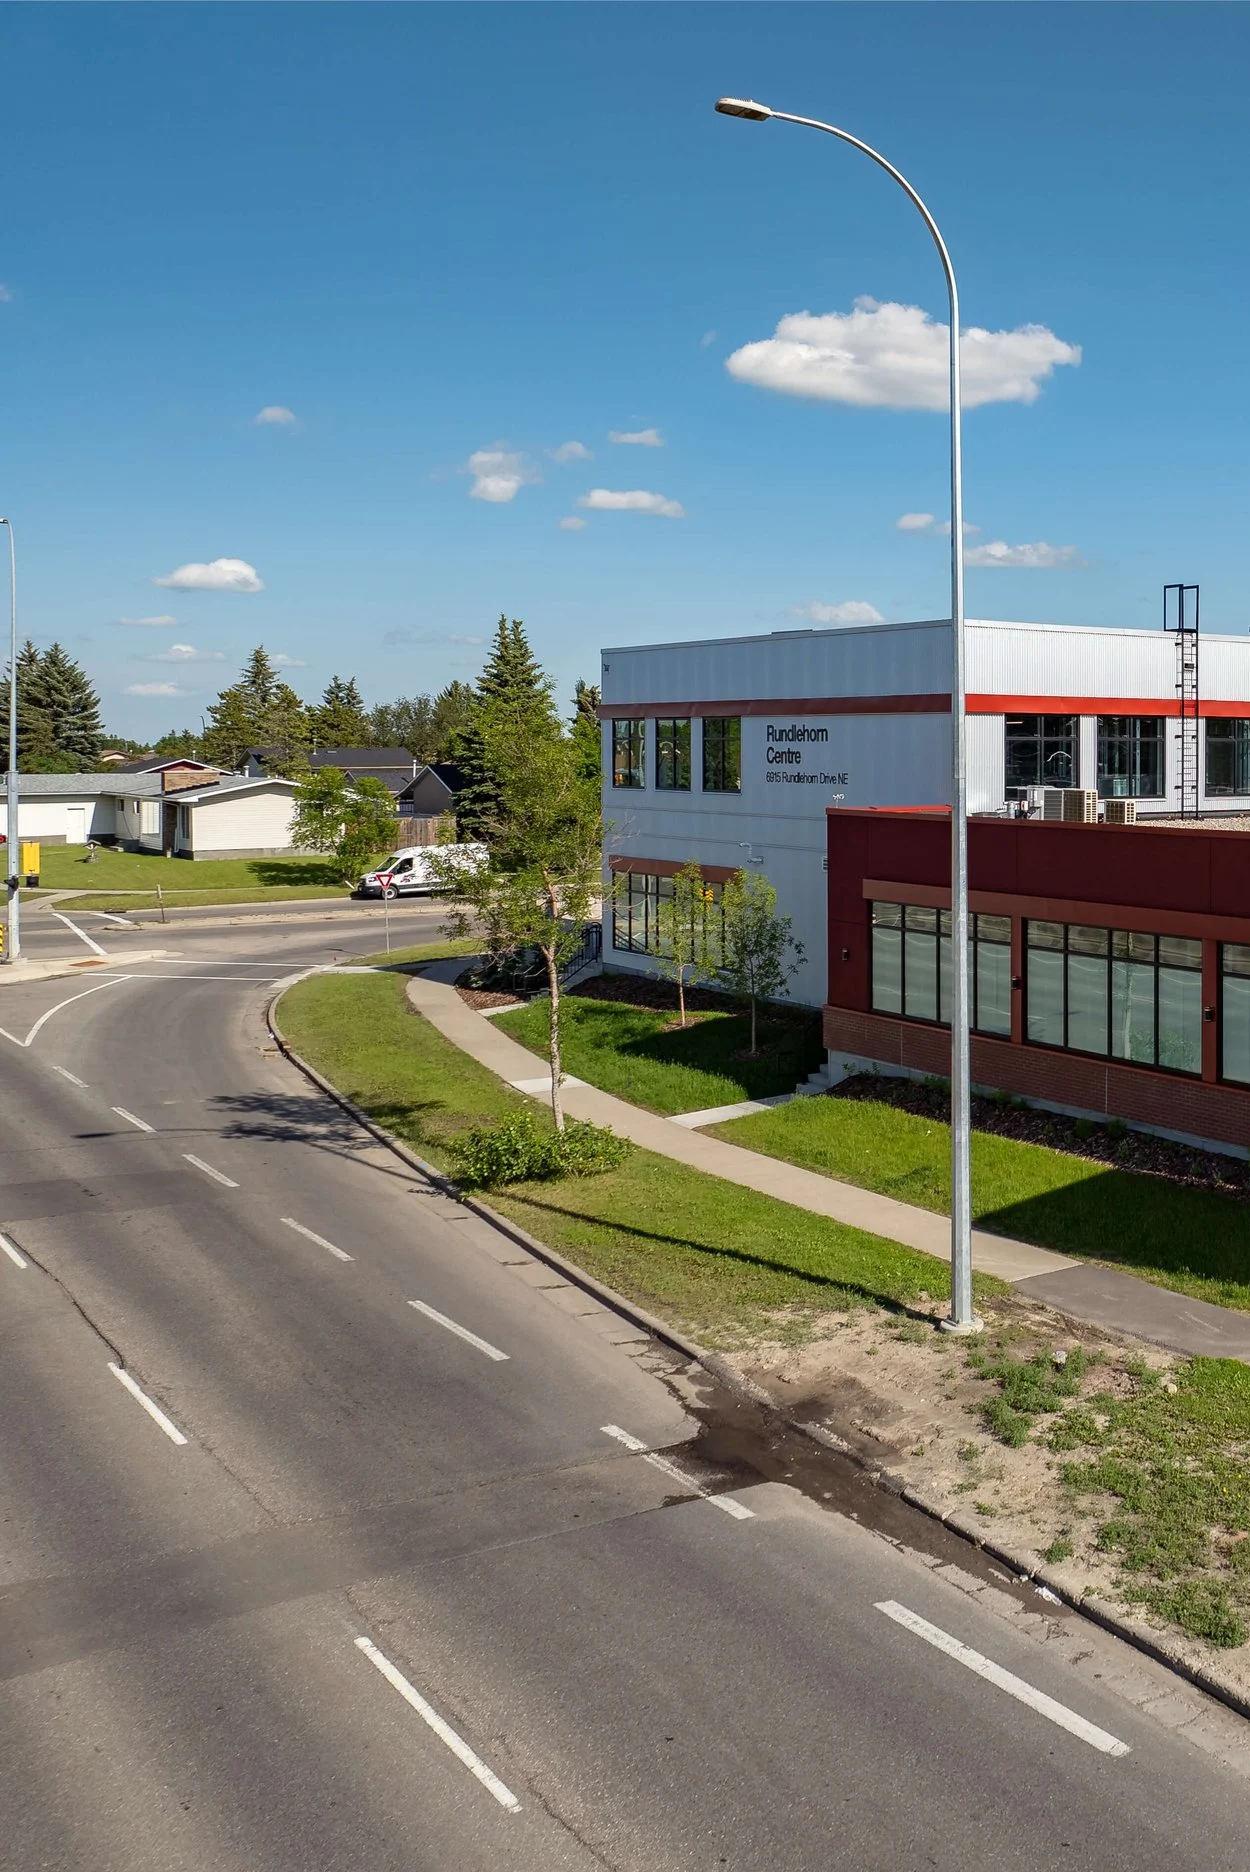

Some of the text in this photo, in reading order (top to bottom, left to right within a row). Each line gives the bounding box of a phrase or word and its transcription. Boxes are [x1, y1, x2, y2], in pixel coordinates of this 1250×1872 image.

[766, 724, 829, 742] Rundlehorn
[766, 746, 801, 764] Centre
[766, 771, 849, 785] 6915 Rundlehorn Drive NE
